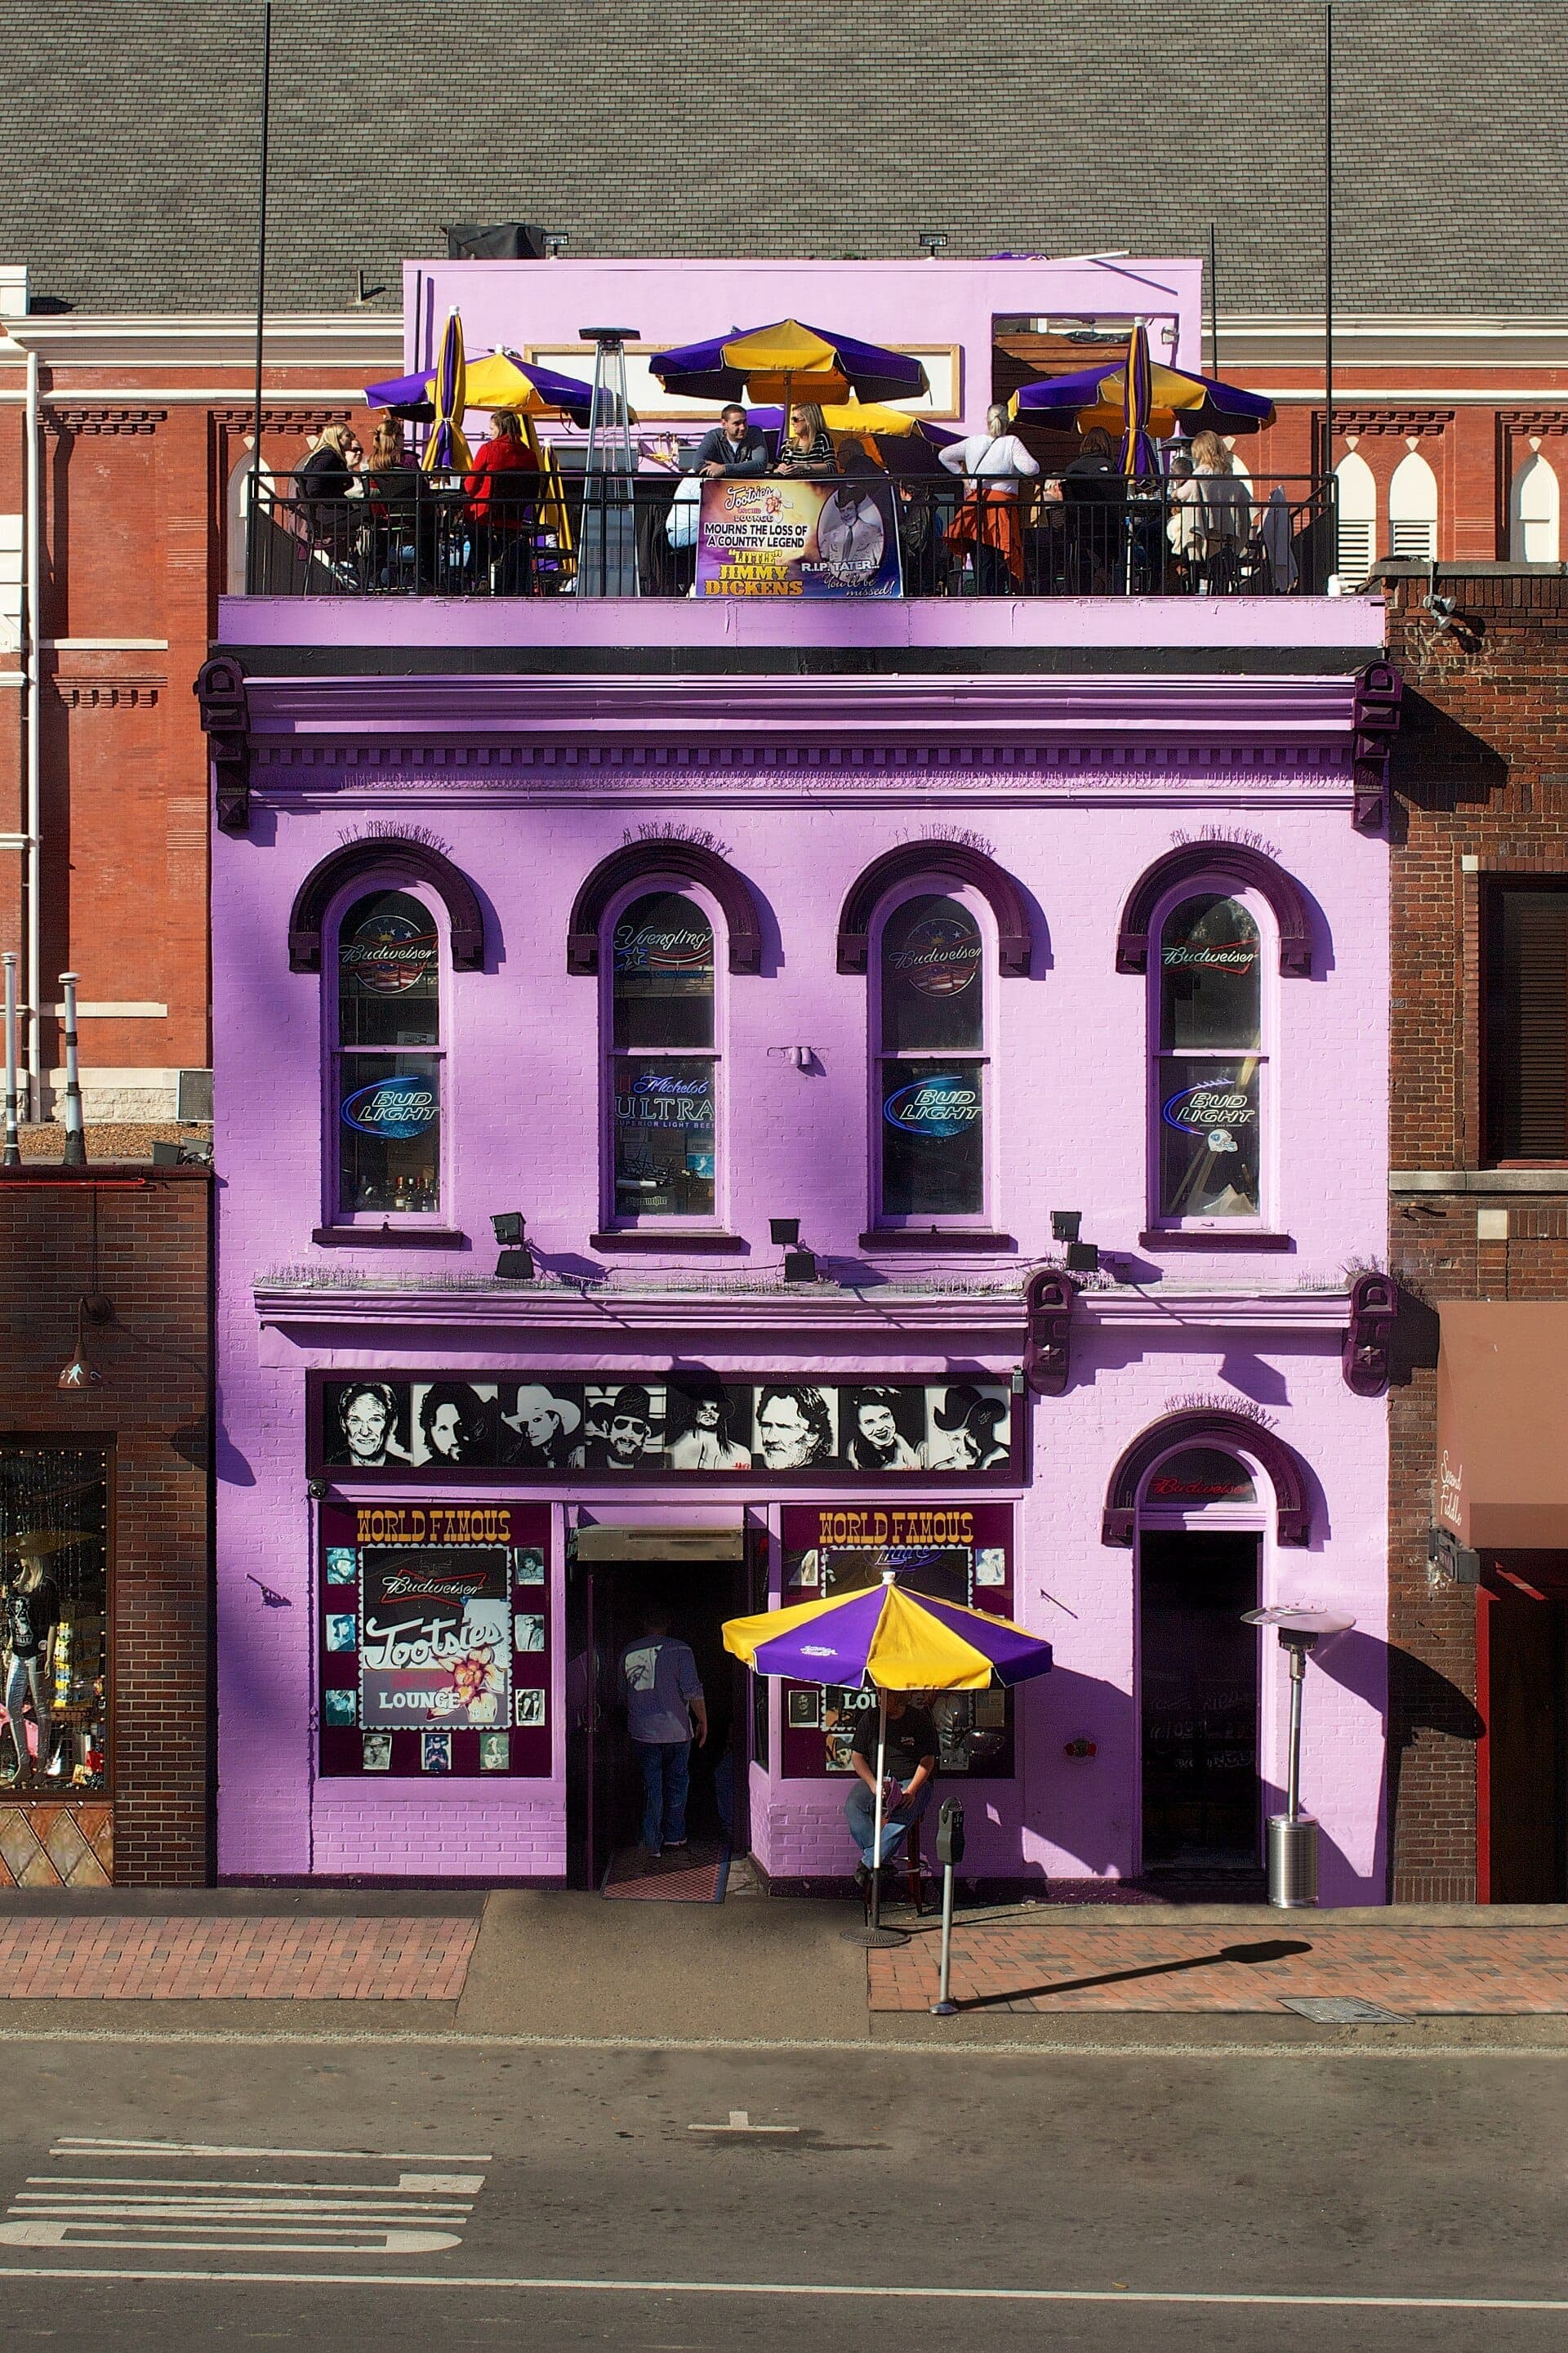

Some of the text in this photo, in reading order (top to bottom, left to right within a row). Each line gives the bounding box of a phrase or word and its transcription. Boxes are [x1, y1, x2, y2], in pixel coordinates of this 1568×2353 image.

[724, 485, 774, 510] Tootsies
[734, 515, 774, 523] LOUNGE
[705, 524, 808, 537] MOURNS THE LOSS OF
[707, 537, 804, 548] A COUNTRY LEGEND
[719, 564, 788, 581] JIMMY
[801, 563, 831, 572] R.I.P.
[705, 580, 804, 596] DICKENS
[863, 573, 876, 586] be
[846, 581, 895, 596] missed!
[613, 925, 714, 951] Yuengling
[339, 944, 438, 962] Budweiser
[889, 946, 982, 969] Budweiser
[1161, 947, 1258, 965] Budweiser
[633, 1076, 710, 1094] Michelob
[372, 1091, 433, 1107] BUD
[914, 1089, 977, 1106] BUD
[1189, 1092, 1248, 1108] BUD
[357, 1106, 441, 1121] LIGHT
[615, 1096, 715, 1121] ULTRA
[899, 1103, 983, 1120] LIGHT
[1176, 1107, 1256, 1123] LIGHT
[662, 1121, 689, 1129] LIGHT
[1150, 1477, 1254, 1496] Budweiser
[1440, 1484, 1463, 1526] Fiddle
[356, 1510, 511, 1542] WORLD FAMOUS
[818, 1512, 974, 1544] WORLD FAMOUS
[381, 1576, 483, 1595] Budweiser
[365, 1615, 506, 1671] Tootsies
[378, 1691, 462, 1710] LOUNGE
